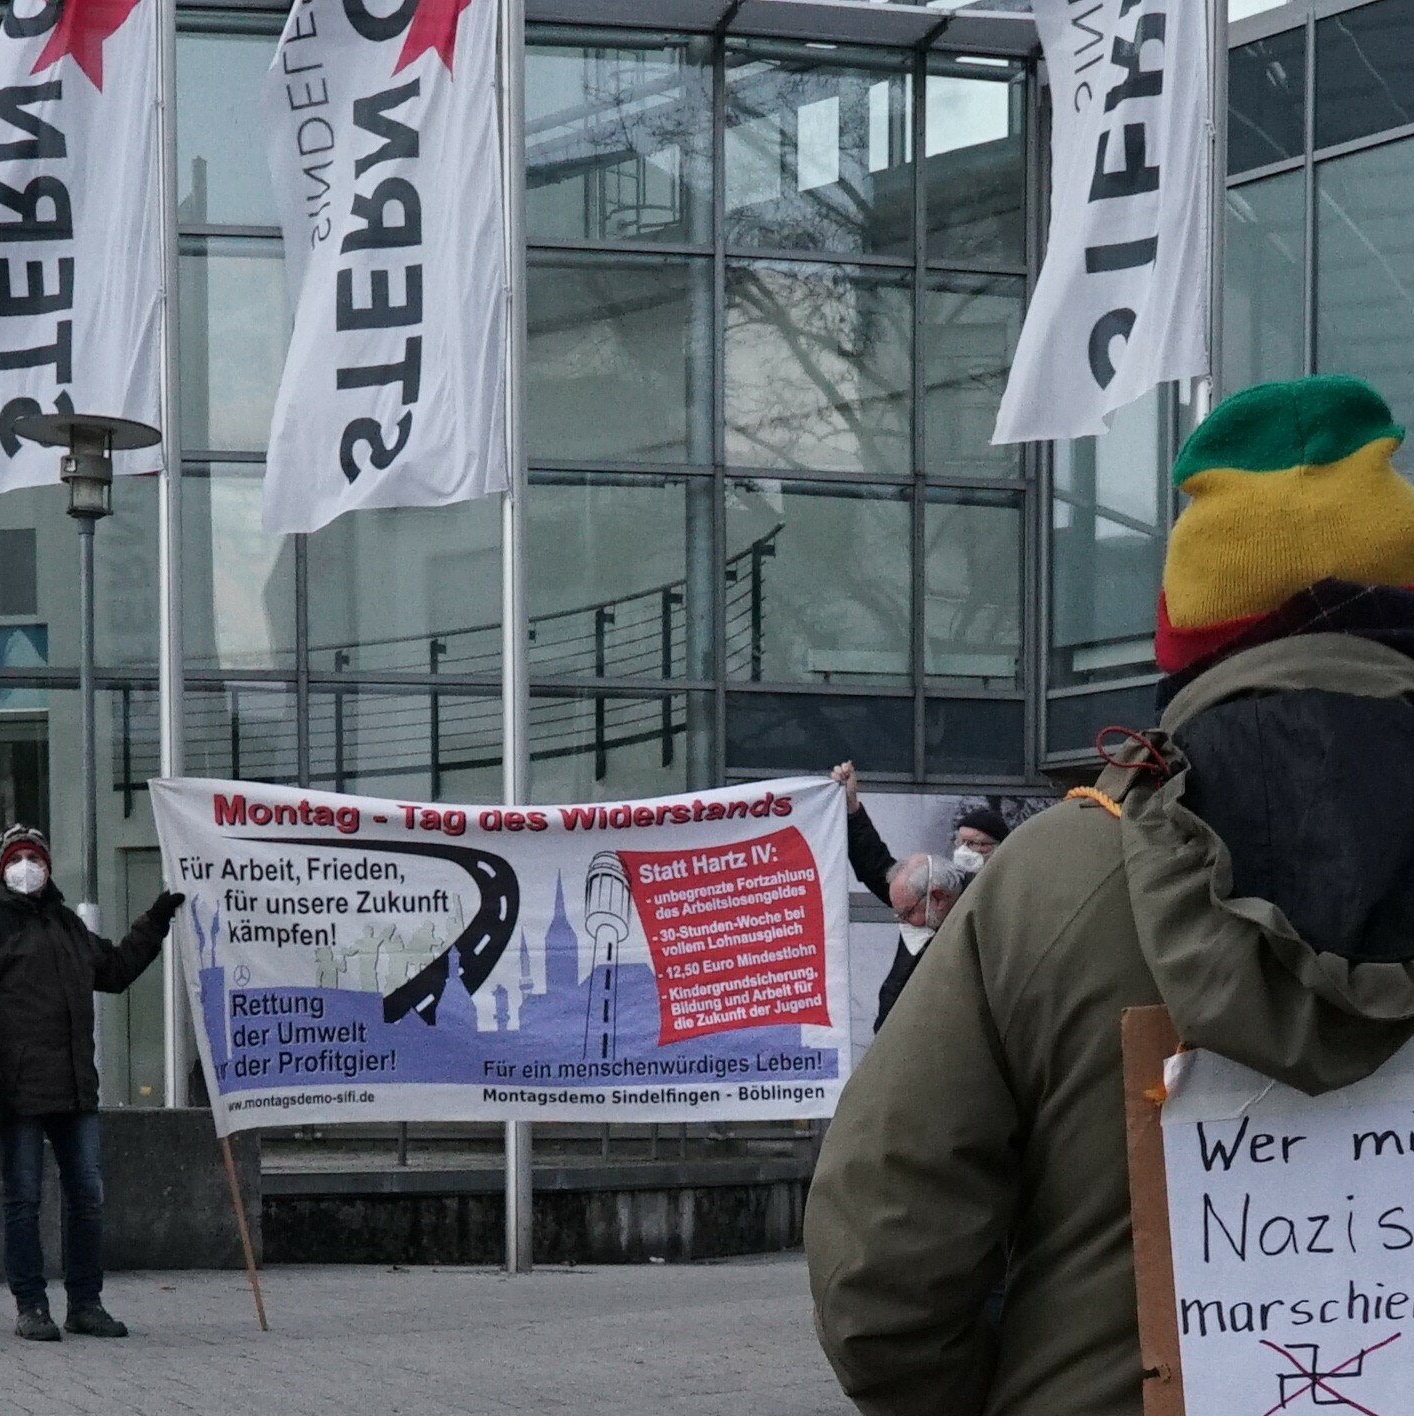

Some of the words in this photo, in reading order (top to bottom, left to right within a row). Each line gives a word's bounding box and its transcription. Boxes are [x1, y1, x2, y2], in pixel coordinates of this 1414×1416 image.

[213, 793, 360, 834] Montag
[397, 804, 467, 836] Tag
[479, 808, 549, 832] des
[557, 791, 793, 831] Widerstands
[179, 857, 215, 881] Für
[221, 857, 301, 886] Arbeit,
[307, 857, 406, 883] Frieden,
[638, 860, 689, 884] Statt
[692, 850, 747, 876] Hartz
[750, 843, 779, 866] IV:
[224, 889, 259, 912] für
[266, 894, 349, 915] unsere
[356, 889, 449, 914] Zukunft
[654, 881, 735, 906] unbegrenzte
[736, 867, 815, 891] Fortzahlung
[655, 904, 680, 920] des
[681, 884, 806, 915] Arbeitslosengeldes
[227, 920, 337, 948] kämpfen!
[659, 911, 782, 943] 30-Stunden-Woche
[784, 906, 805, 921] bei
[661, 940, 706, 957] vollem
[707, 922, 803, 949] Lohnausgleich
[666, 961, 700, 980] 12,50
[703, 957, 735, 974] Euro
[736, 943, 817, 968] Mindestlohn
[668, 966, 819, 1001] Kindergrundsicherung,
[671, 996, 722, 1016] Bildung
[724, 991, 750, 1007] und
[752, 985, 792, 1003] Arbeit
[794, 980, 814, 995] für
[232, 993, 325, 1020] Rettung
[673, 1017, 695, 1031] die
[696, 1007, 748, 1027] Zukunft
[749, 1002, 770, 1018] der
[773, 993, 823, 1014] Jugend
[233, 1027, 270, 1048] der
[277, 1021, 367, 1045] Umwelt
[235, 1056, 278, 1079] der
[278, 1049, 397, 1078] Profitgier!
[483, 1059, 516, 1078] Für
[522, 1059, 552, 1079] ein
[557, 1053, 750, 1079] menschenwürdiges
[755, 1050, 823, 1073] Leben!
[482, 1087, 607, 1107] Montagsdemo
[611, 1088, 719, 1106] Sindelfingen
[738, 1085, 825, 1103] Böblingen
[1197, 1114, 1308, 1173] Wer
[1202, 1192, 1414, 1264] Nazis
